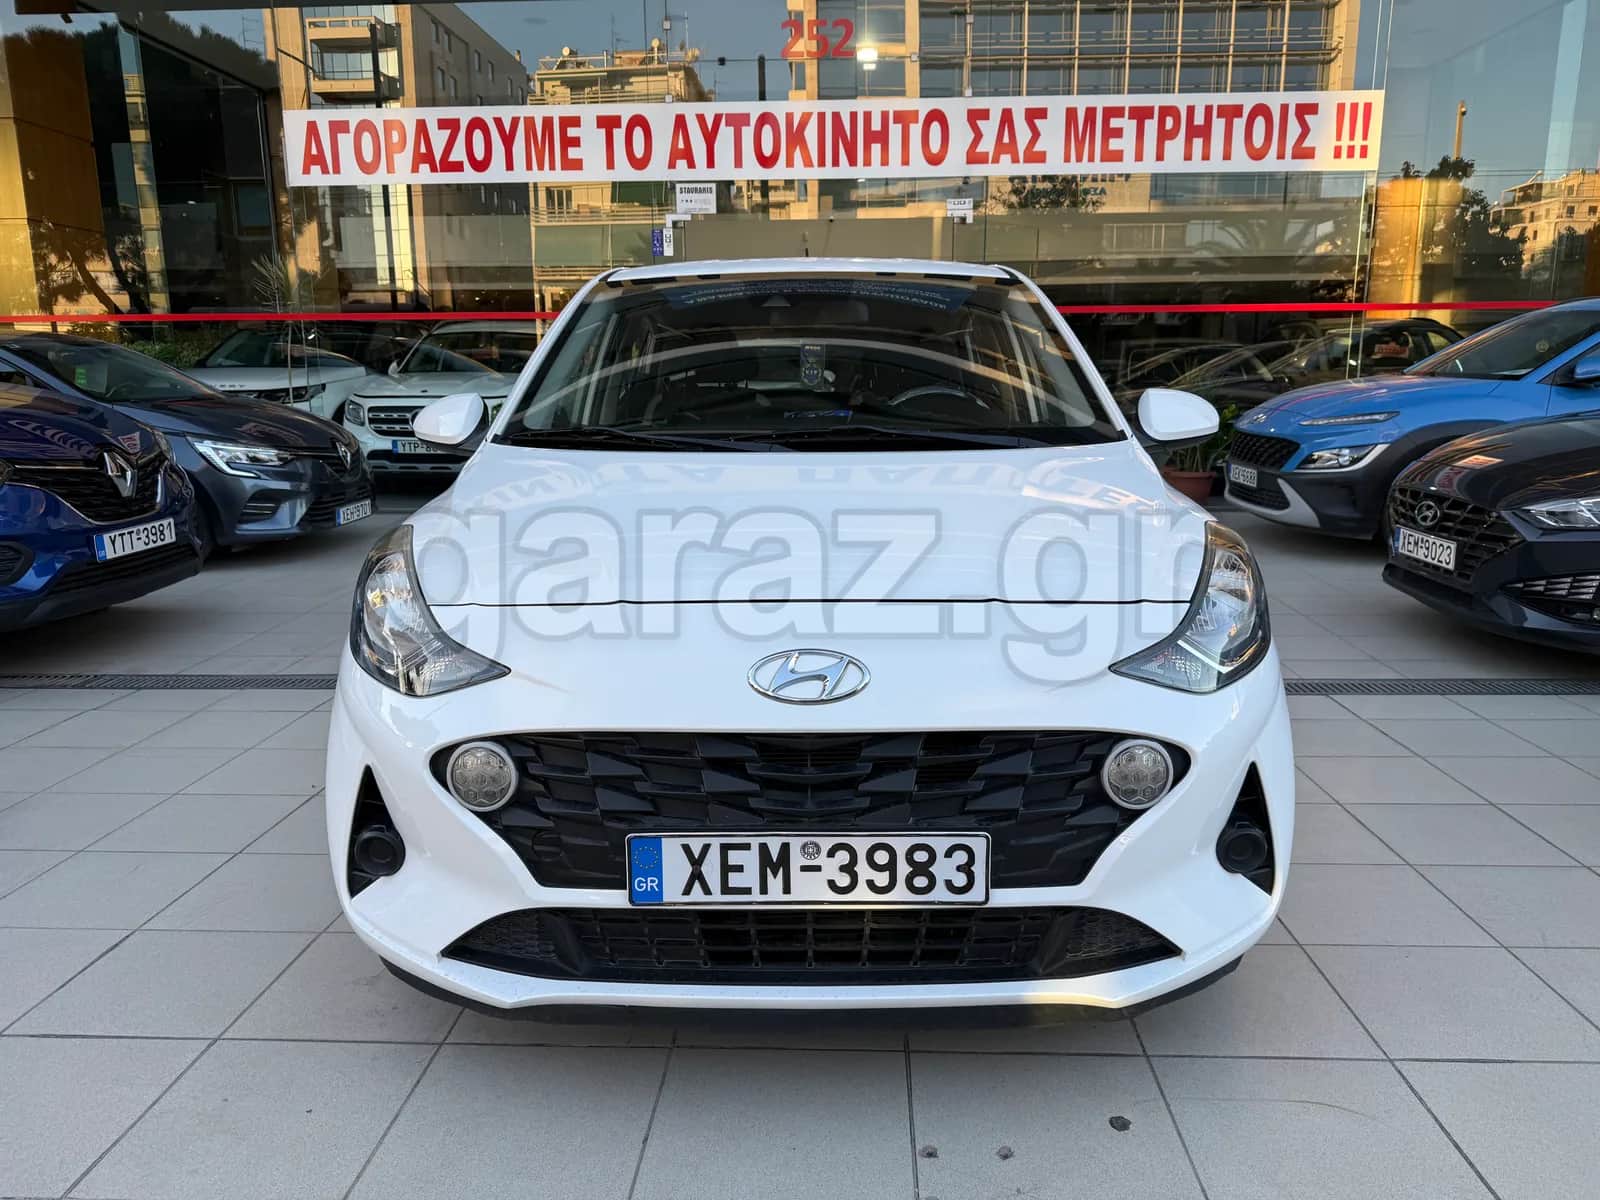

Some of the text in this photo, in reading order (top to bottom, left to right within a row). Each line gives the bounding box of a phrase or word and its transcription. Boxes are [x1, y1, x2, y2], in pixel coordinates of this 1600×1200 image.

[781, 18, 855, 59] 252
[302, 101, 1373, 175] ΑΓΟΡΑΖΟΥΜΕ ΤΟ ΑΥΤΟΚΙΝΗΤΟ ΣΑΣ ΜΕΤΡΗΤΟΙΣ !!!
[108, 520, 174, 555] YTT-3981
[1400, 529, 1453, 567] XEM-9023
[634, 876, 659, 892] GR
[680, 841, 976, 897] XEM-3983
